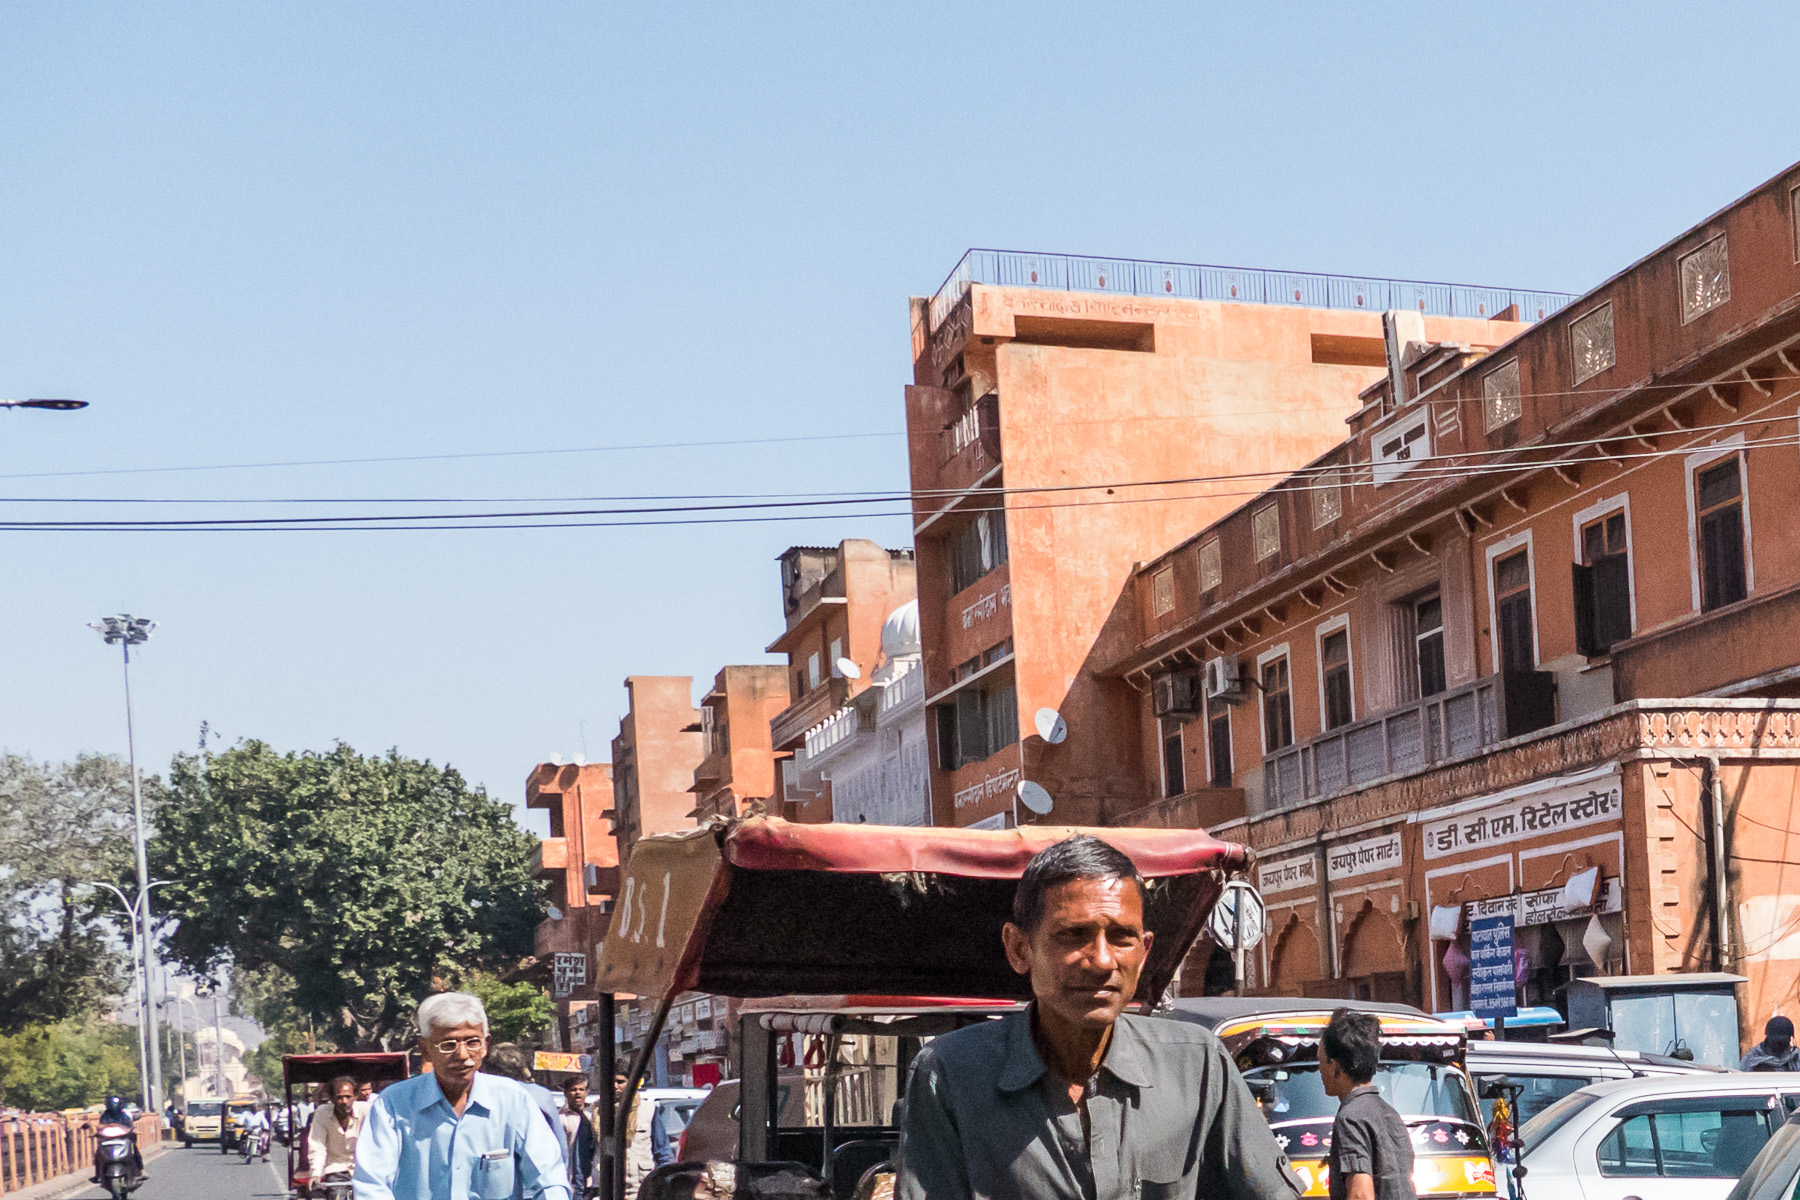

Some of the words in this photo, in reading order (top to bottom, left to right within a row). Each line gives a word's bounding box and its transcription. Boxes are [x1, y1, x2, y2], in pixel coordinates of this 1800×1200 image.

[1520, 802, 1567, 831] रिटेल
[1569, 790, 1610, 820] स्टोर
[1331, 852, 1357, 873] जयपुर
[1358, 847, 1375, 864] पेपर
[1376, 839, 1394, 861] मार्ट
